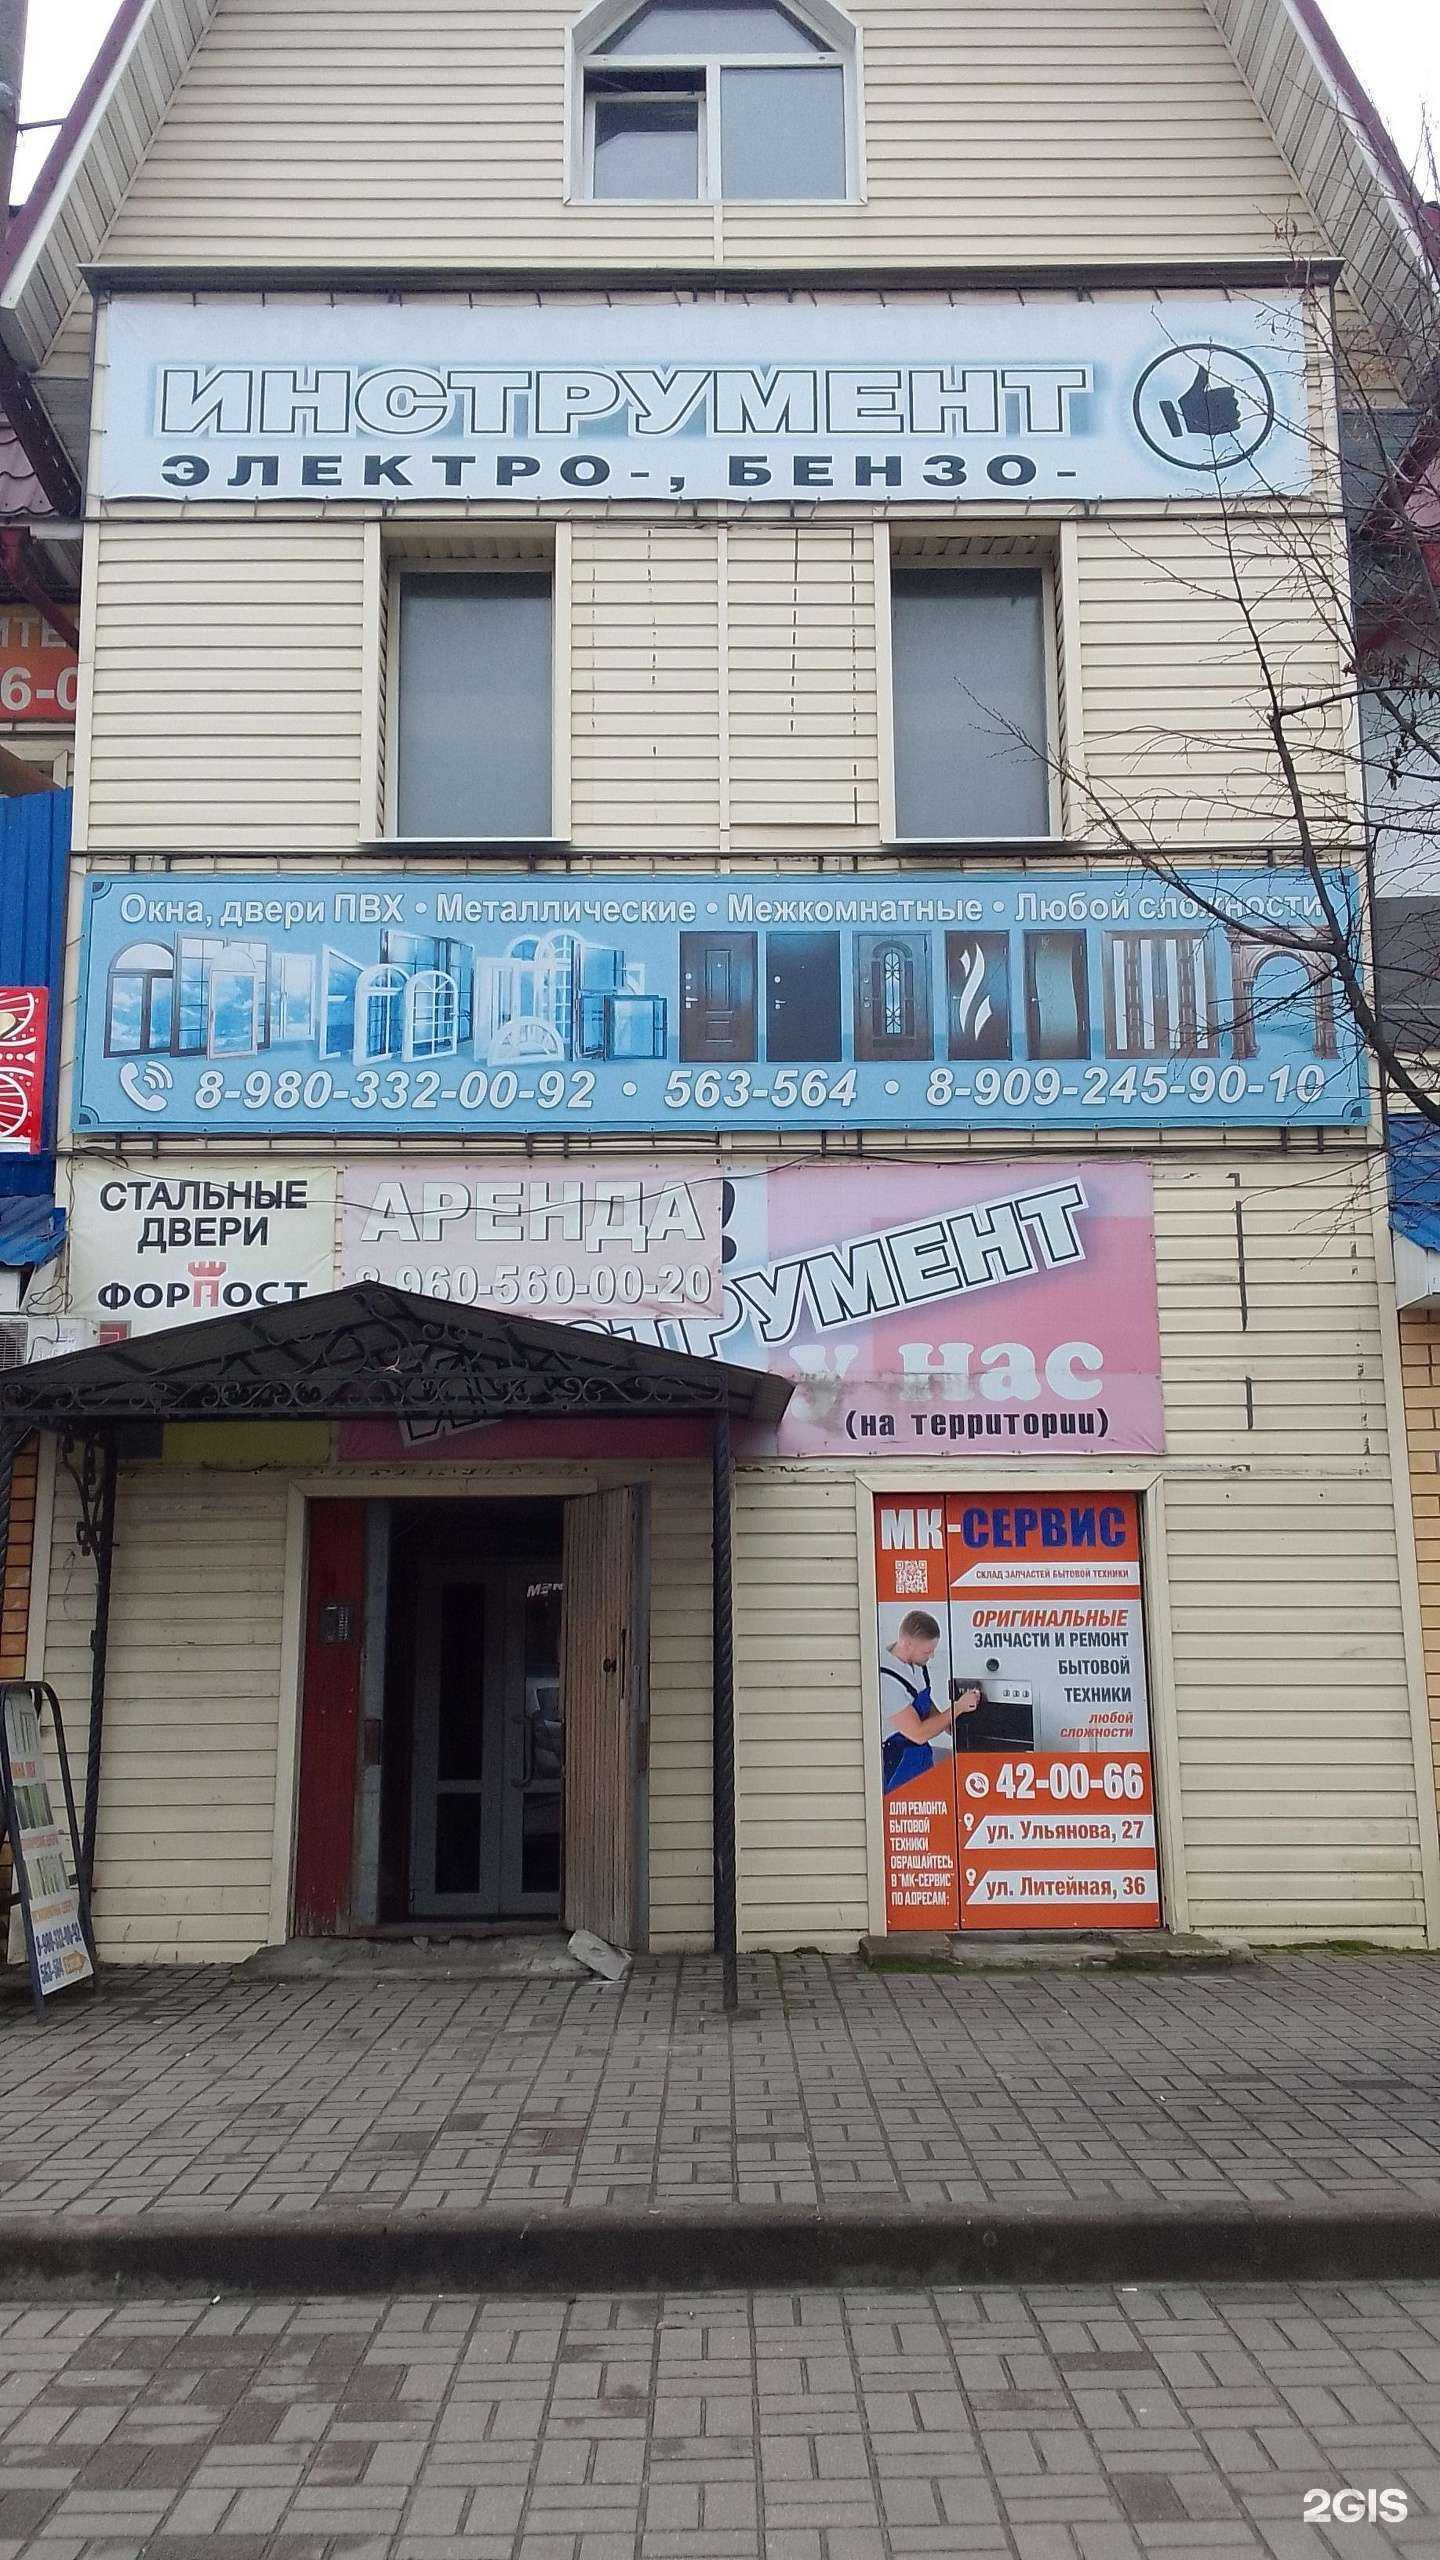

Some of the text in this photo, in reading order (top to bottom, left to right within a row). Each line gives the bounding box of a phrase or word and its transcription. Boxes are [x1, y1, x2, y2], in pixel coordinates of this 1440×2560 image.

[160, 366, 1088, 436] ИНСТРУМЕНТ
[161, 454, 1078, 494] ЭЛЕКТРО-, БЕНЗО-
[121, 893, 213, 927] Окна,
[220, 899, 325, 929] двери
[333, 893, 404, 923] ПВХ
[436, 892, 697, 923] Металлические
[727, 892, 983, 923] Межкомнатные
[1015, 890, 1130, 921] Любой
[194, 1064, 1327, 1111] 8-980-332-00-92 563-564 8-909-245-90-10
[99, 1179, 308, 1211] СТАЛЬНЫЕ
[360, 1180, 706, 1254] АРЕНДА
[137, 1216, 269, 1254] ДВЕРИ
[898, 1340, 1104, 1402] нас
[844, 1407, 1109, 1440] (на территории)
[880, 1506, 1126, 1550] МК-СЕРВИС
[976, 1568, 1129, 1580] СКЛАД ЗАПЧАСТЕЙ БЫТОВОЙ ТЕХНИКИ
[972, 1609, 1129, 1628] ОРИГИНАЛЬНЫЕ
[974, 1631, 1129, 1649] ЗАПЧАСТИ И РЕМОНТ
[1058, 1656, 1131, 1675] БЫТОВОЙ
[1064, 1686, 1132, 1703] ТЕХНИКИ
[1088, 1711, 1134, 1725] любой
[1060, 1726, 1134, 1739] сложности
[996, 1762, 1144, 1800] 42-00-66
[889, 1800, 948, 1816] ДЛЯ РЕМОНТА
[889, 1816, 931, 1834] БЫТОВОЙ
[986, 1820, 1145, 1844] ул. Ульянова, 27
[890, 1837, 929, 1852] ТЕХНИКИ
[890, 1853, 954, 1870] ОБРАЩАЙТЕСЬ
[891, 1873, 898, 1888] В
[986, 1876, 1146, 1900] ул. Литейная, 36
[891, 1891, 950, 1907] ПО АДРЕСАМ:
